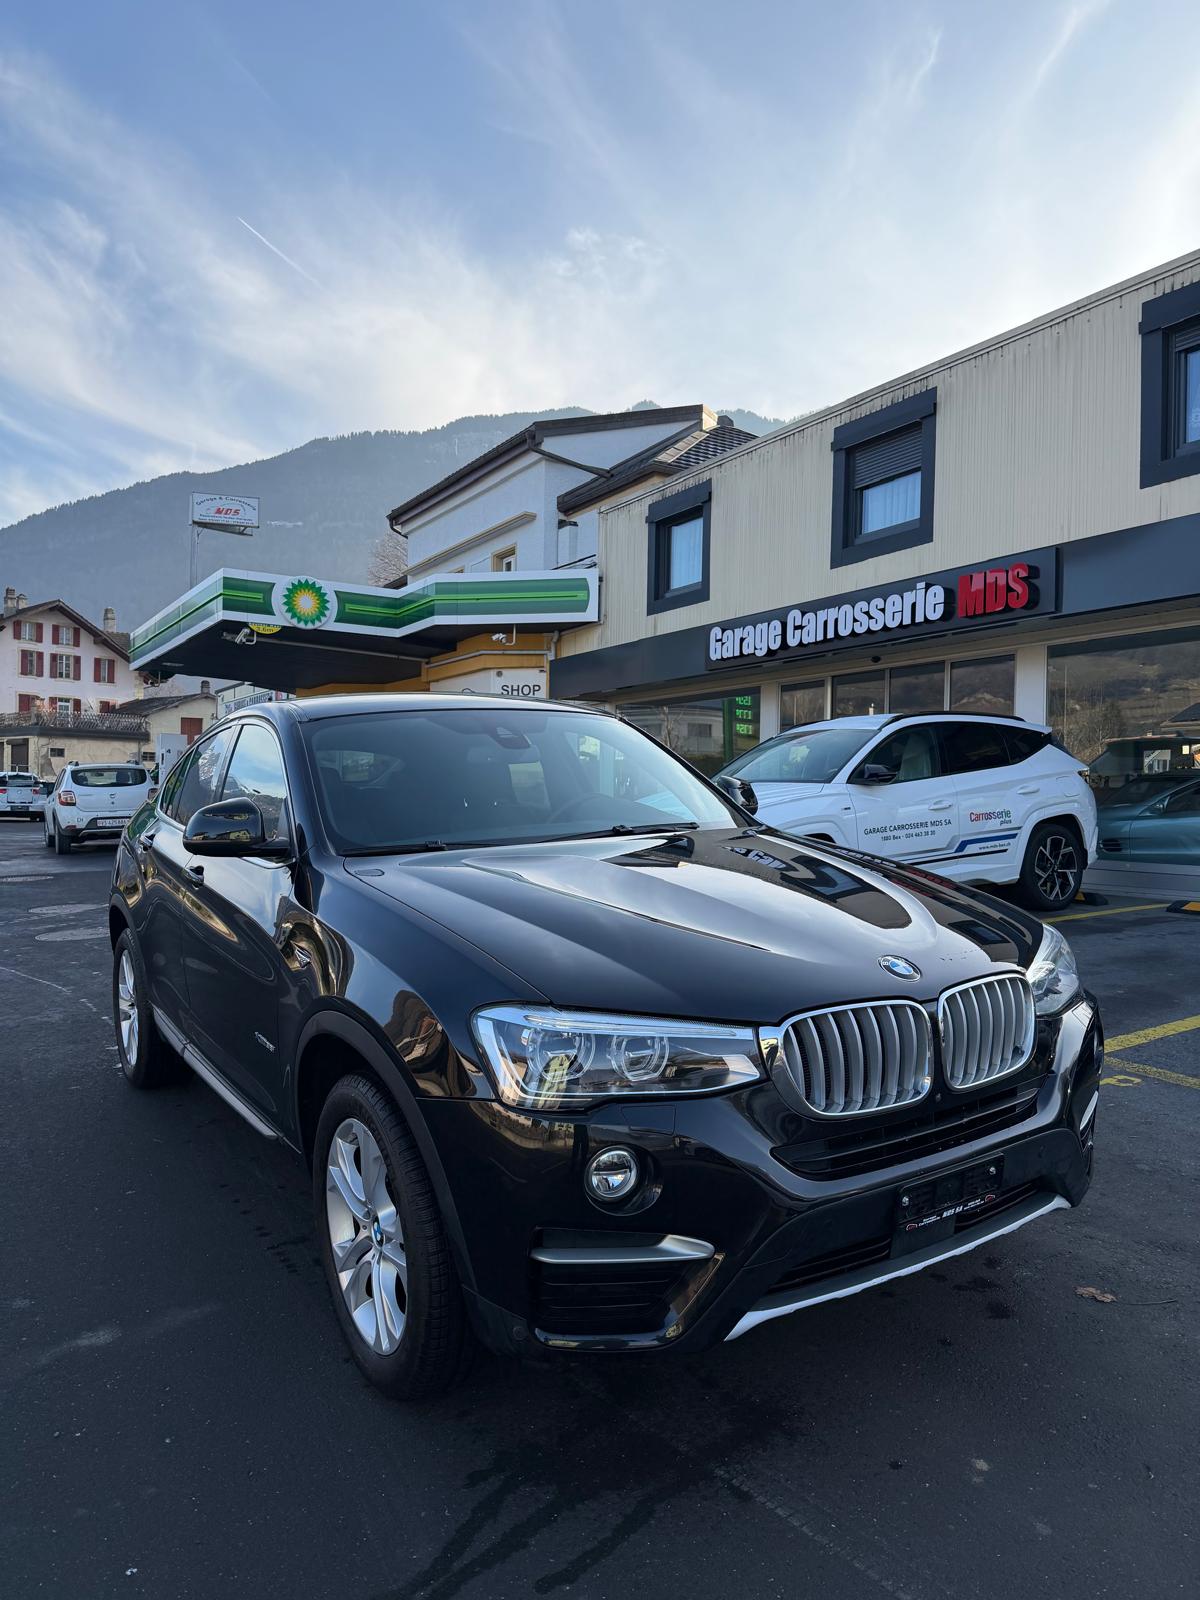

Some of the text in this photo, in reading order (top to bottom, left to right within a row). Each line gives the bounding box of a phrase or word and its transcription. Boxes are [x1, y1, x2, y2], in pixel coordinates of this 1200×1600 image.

[214, 507, 241, 516] MDS
[709, 562, 1031, 661] Garage Carrosserie MDS
[501, 684, 541, 697] SHOP
[970, 809, 1012, 822] Carrosserie
[863, 818, 952, 836] GARAGE CARROSSERIE MDS SA
